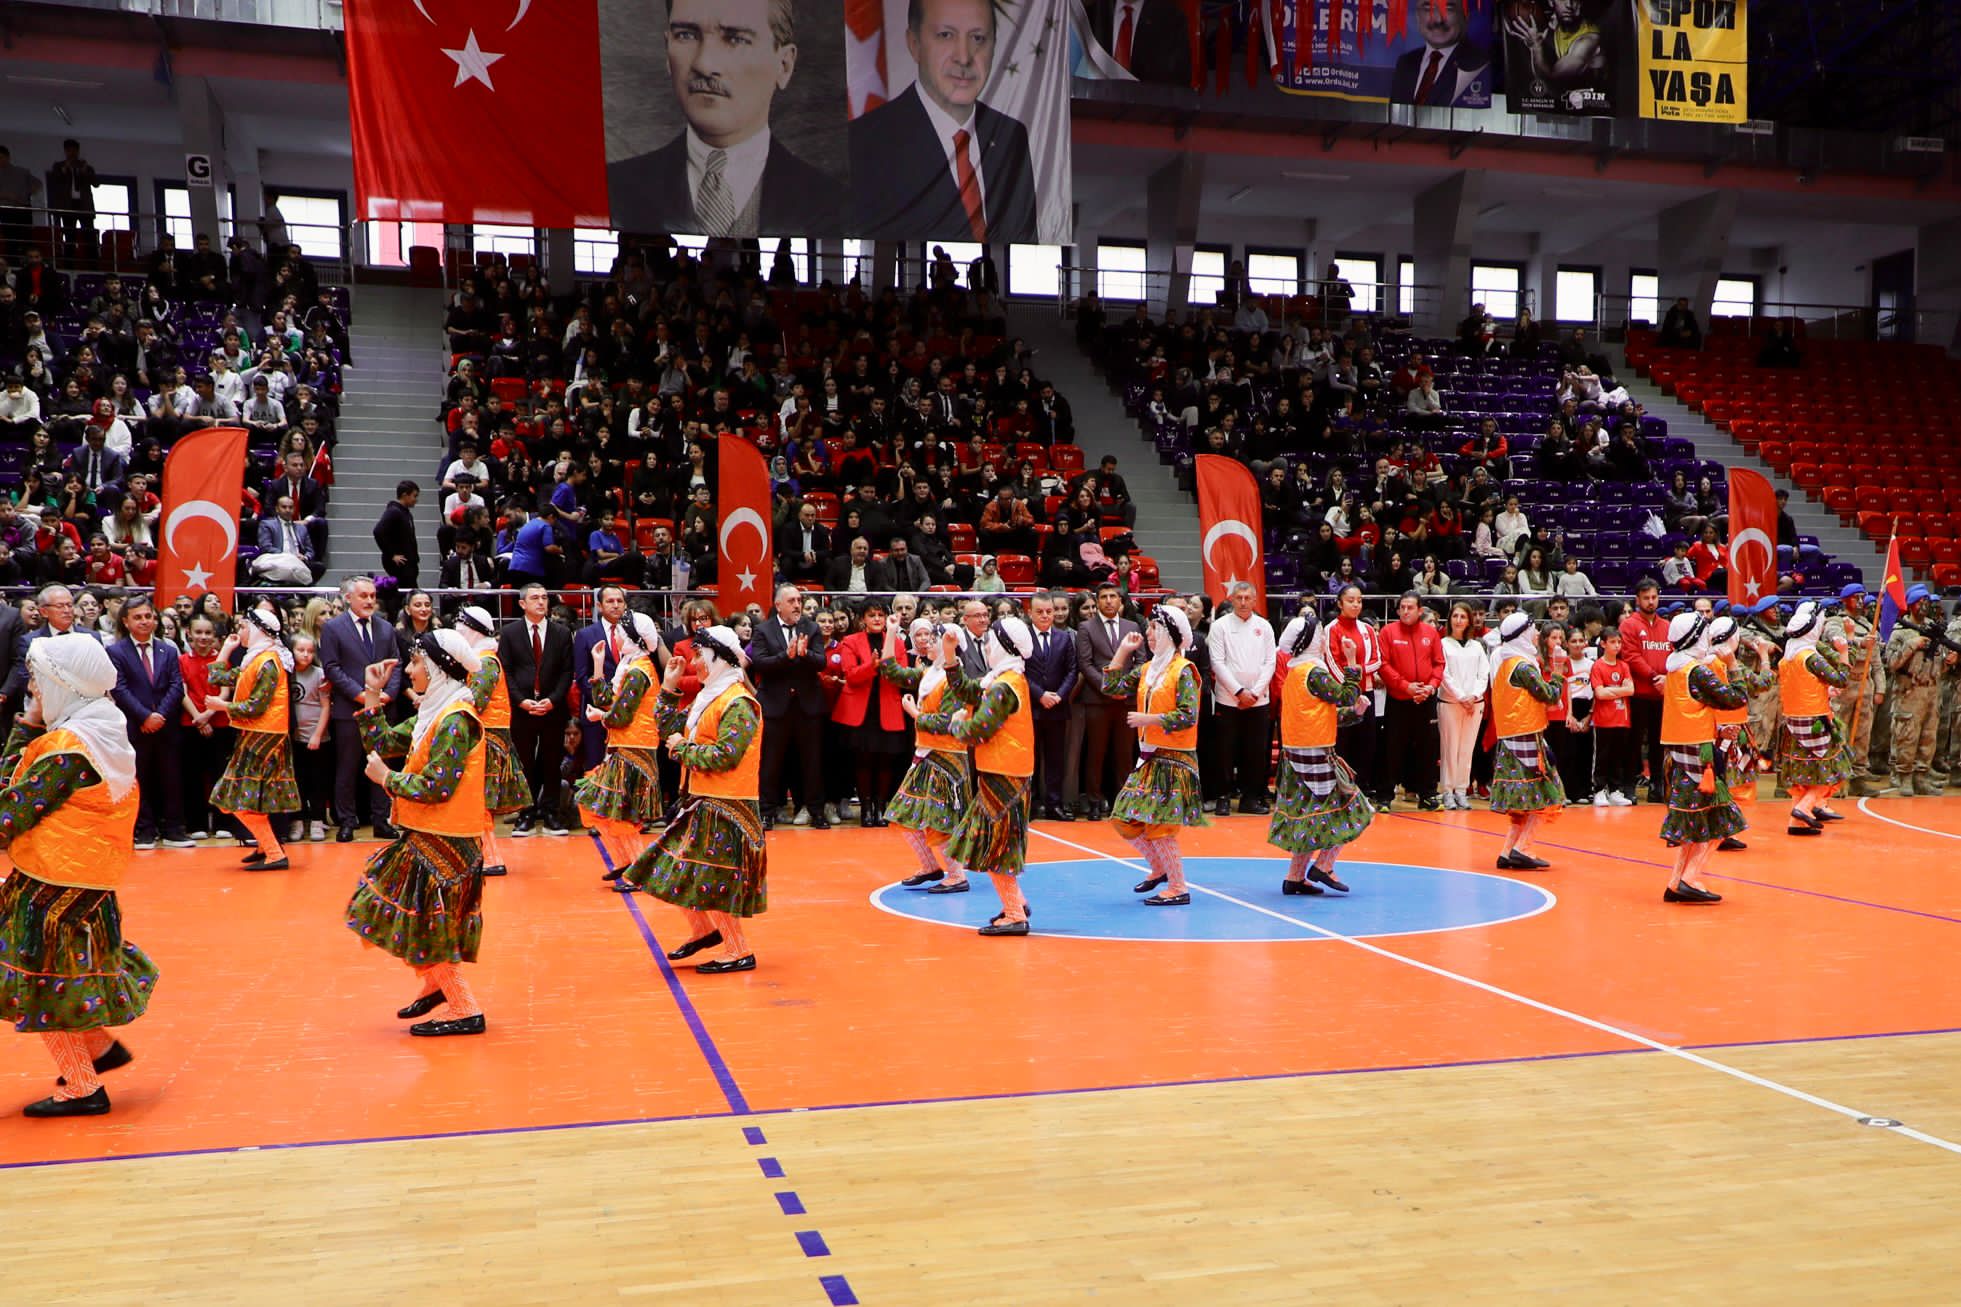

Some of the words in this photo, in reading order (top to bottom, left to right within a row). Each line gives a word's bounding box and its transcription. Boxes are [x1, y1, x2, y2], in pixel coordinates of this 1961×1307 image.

[1650, 0, 1736, 29] SPOR
[1652, 30, 1692, 61] LA
[1649, 69, 1735, 107] YAŞA
[188, 156, 210, 178] G
